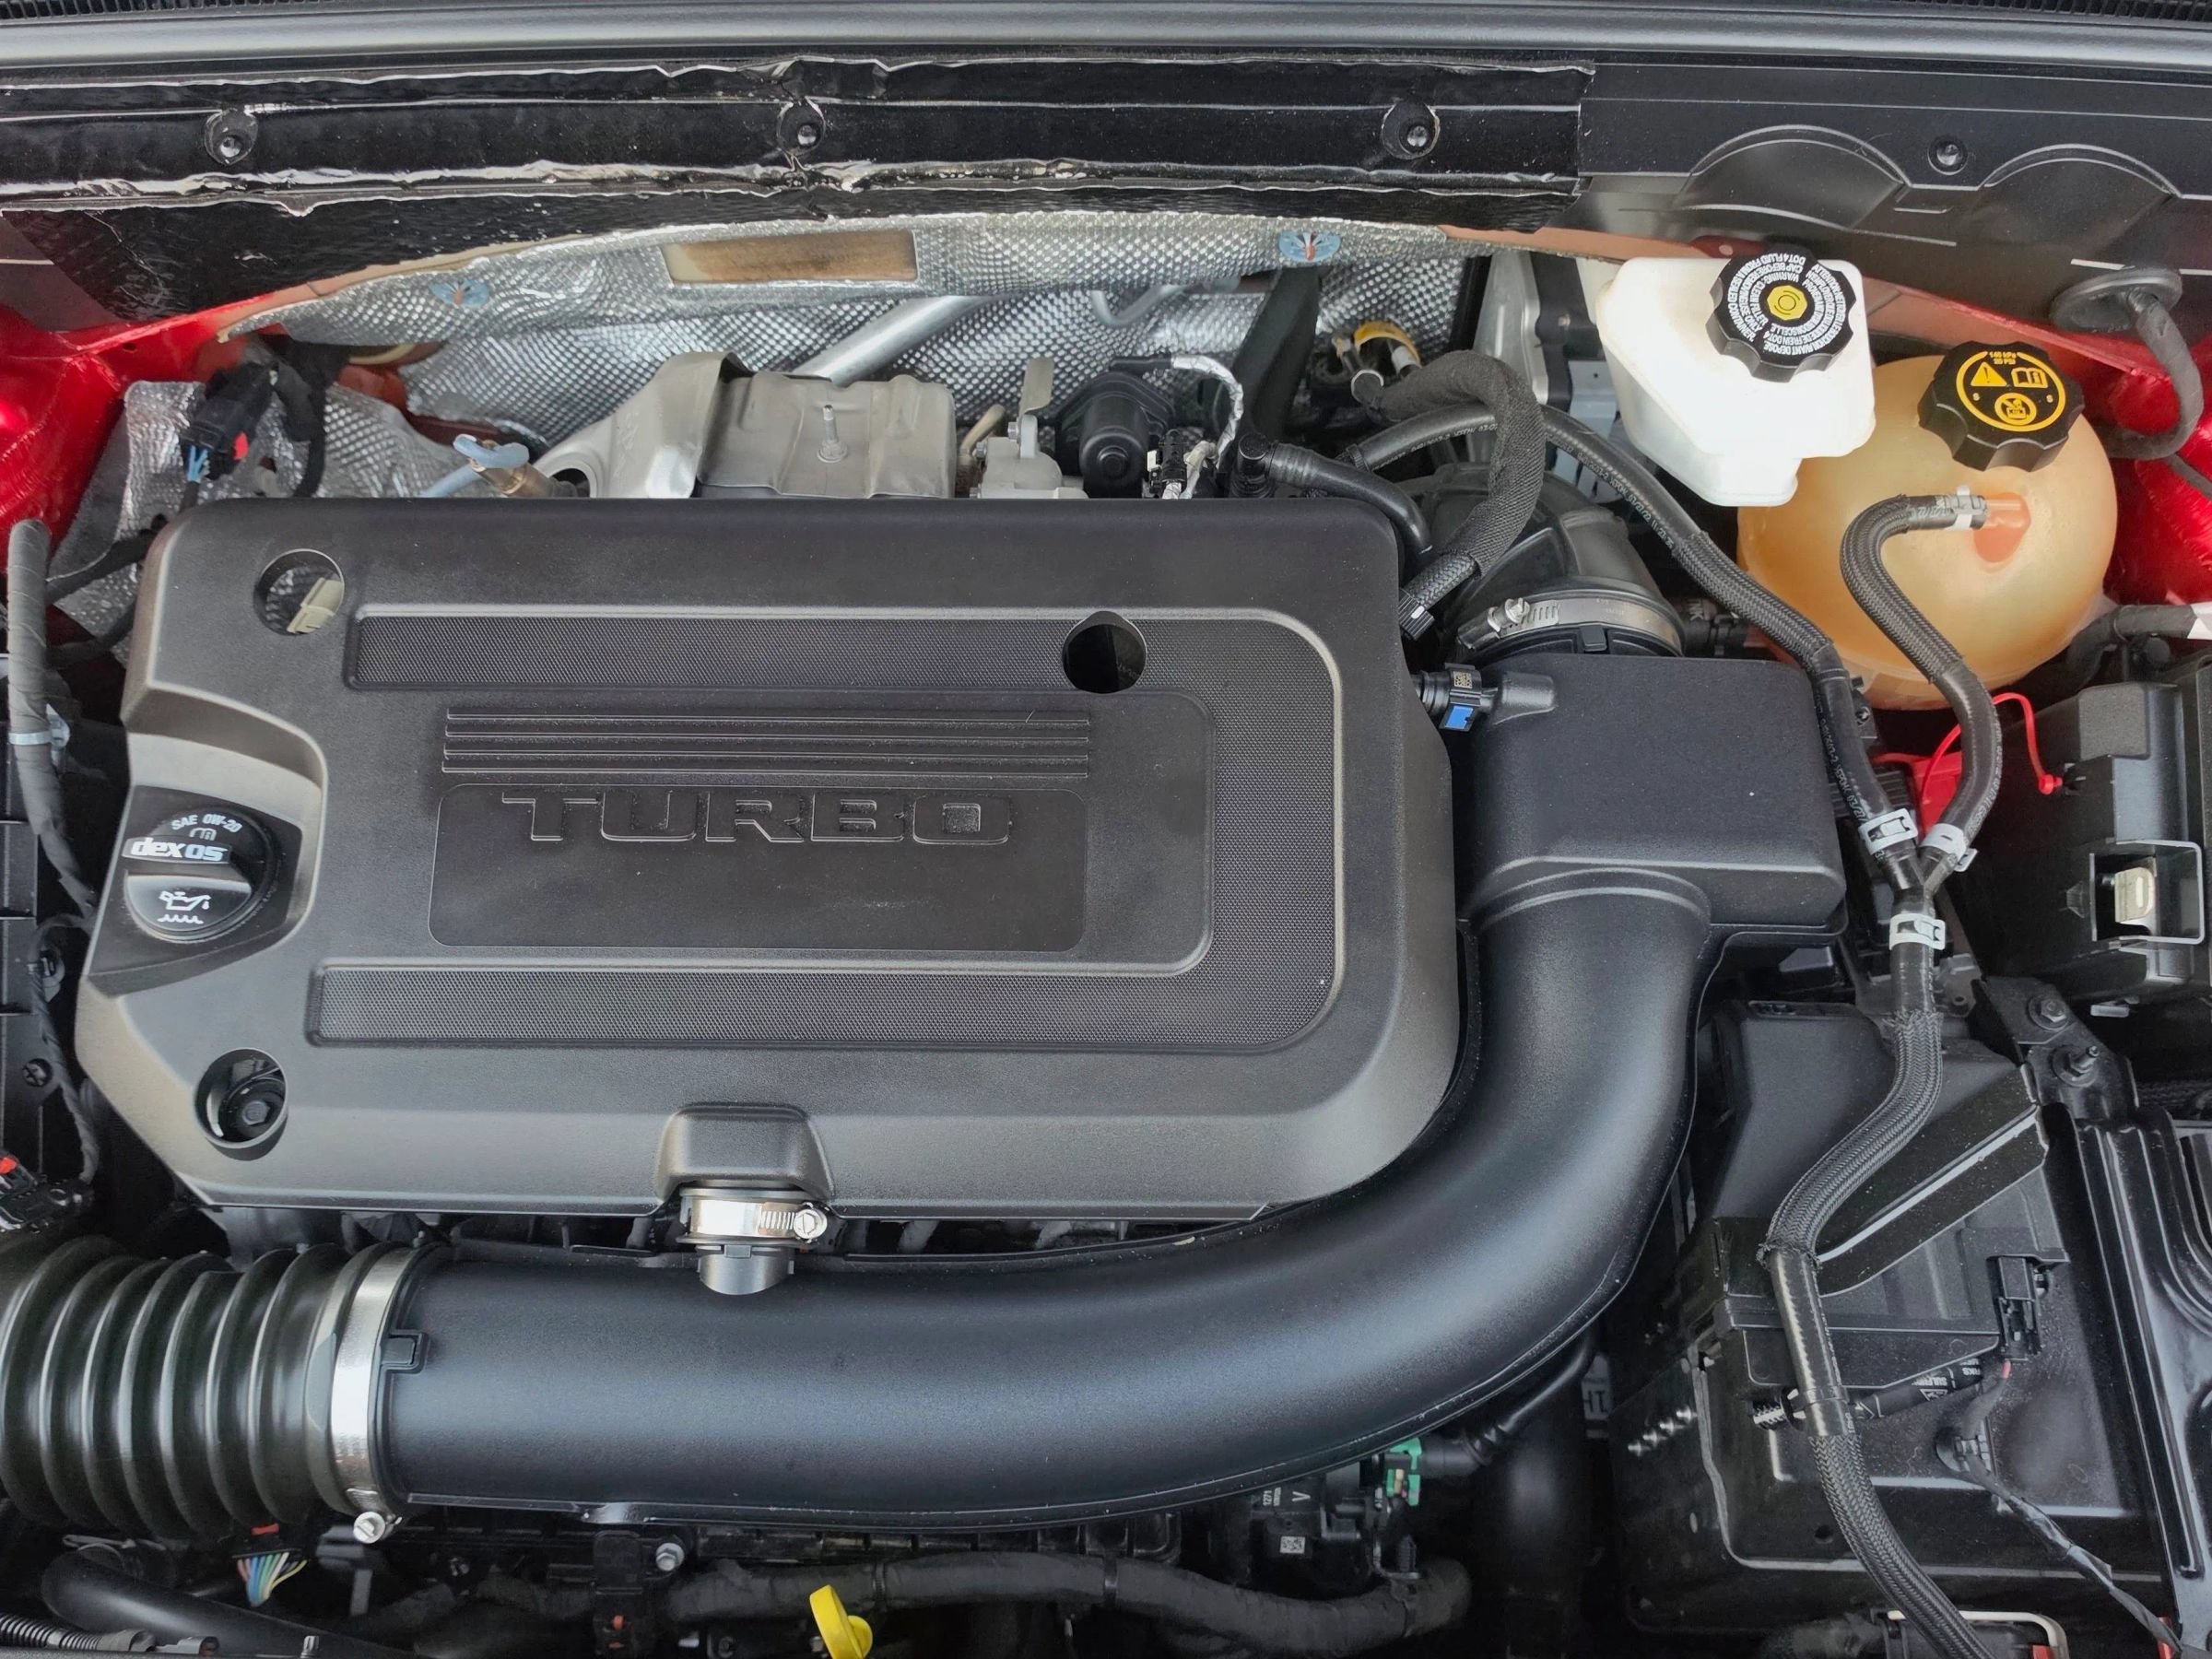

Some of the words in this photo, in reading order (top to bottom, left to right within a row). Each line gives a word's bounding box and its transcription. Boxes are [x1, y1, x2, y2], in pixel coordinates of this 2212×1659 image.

[1740, 258, 1761, 274] FROM
[1759, 252, 1783, 265] FLUID
[1788, 253, 1806, 265] DOT
[1755, 262, 1784, 276] BEFORE
[1786, 262, 1803, 274] CAP
[1761, 272, 1799, 285] WARNING:
[1727, 276, 1742, 301] SEALED
[1749, 280, 1765, 301] CLEAN
[1750, 303, 1768, 325] FILLER
[1743, 315, 1762, 333] ONLY
[1767, 332, 1782, 344] DOT
[1783, 335, 1802, 346] FREIN
[1791, 342, 1814, 355] AVANT
[171, 815, 198, 830] SAE
[203, 814, 242, 832] 0W-20
[501, 790, 1011, 845] TURBO
[131, 838, 229, 862] dexos
